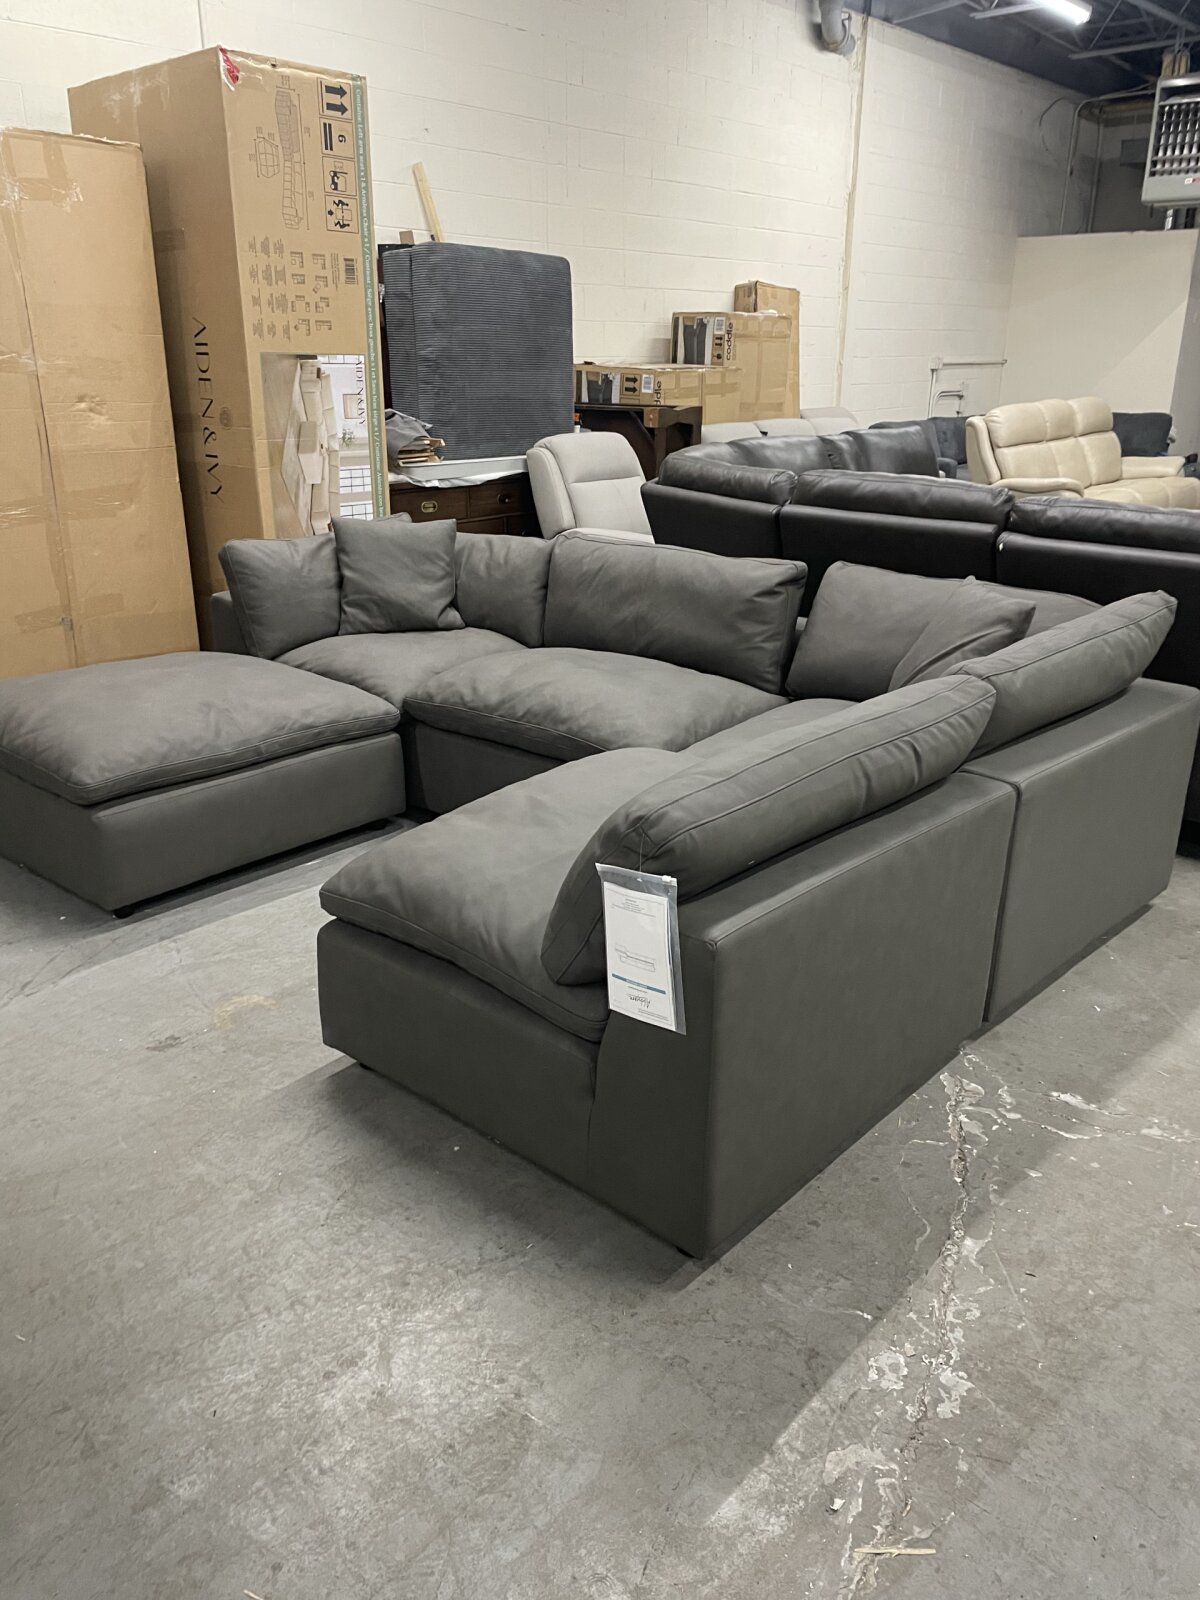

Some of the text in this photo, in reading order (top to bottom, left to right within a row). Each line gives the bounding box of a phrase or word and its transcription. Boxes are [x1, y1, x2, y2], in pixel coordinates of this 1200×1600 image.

[338, 134, 346, 143] 6
[726, 322, 734, 361] coddle
[192, 317, 216, 419] AIDEN
[205, 454, 225, 504] IVY
